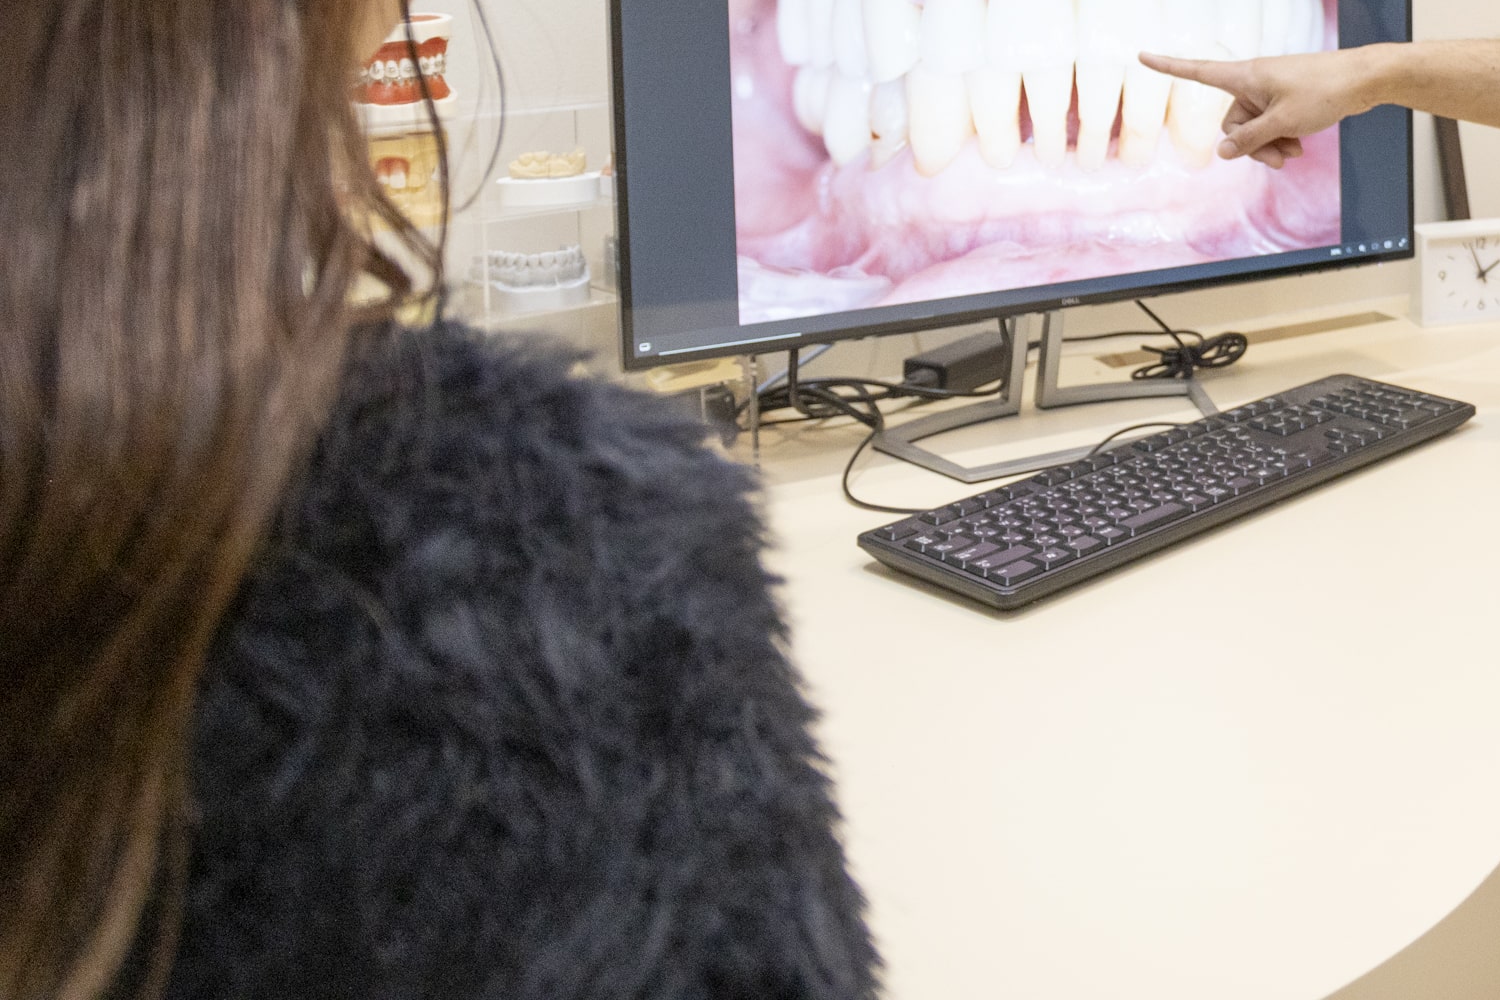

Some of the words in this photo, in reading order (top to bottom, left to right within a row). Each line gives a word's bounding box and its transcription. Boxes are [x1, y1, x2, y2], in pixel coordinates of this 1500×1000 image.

[1475, 236, 1486, 250] 12
[1438, 270, 1446, 281] 9
[1477, 299, 1485, 311] 6
